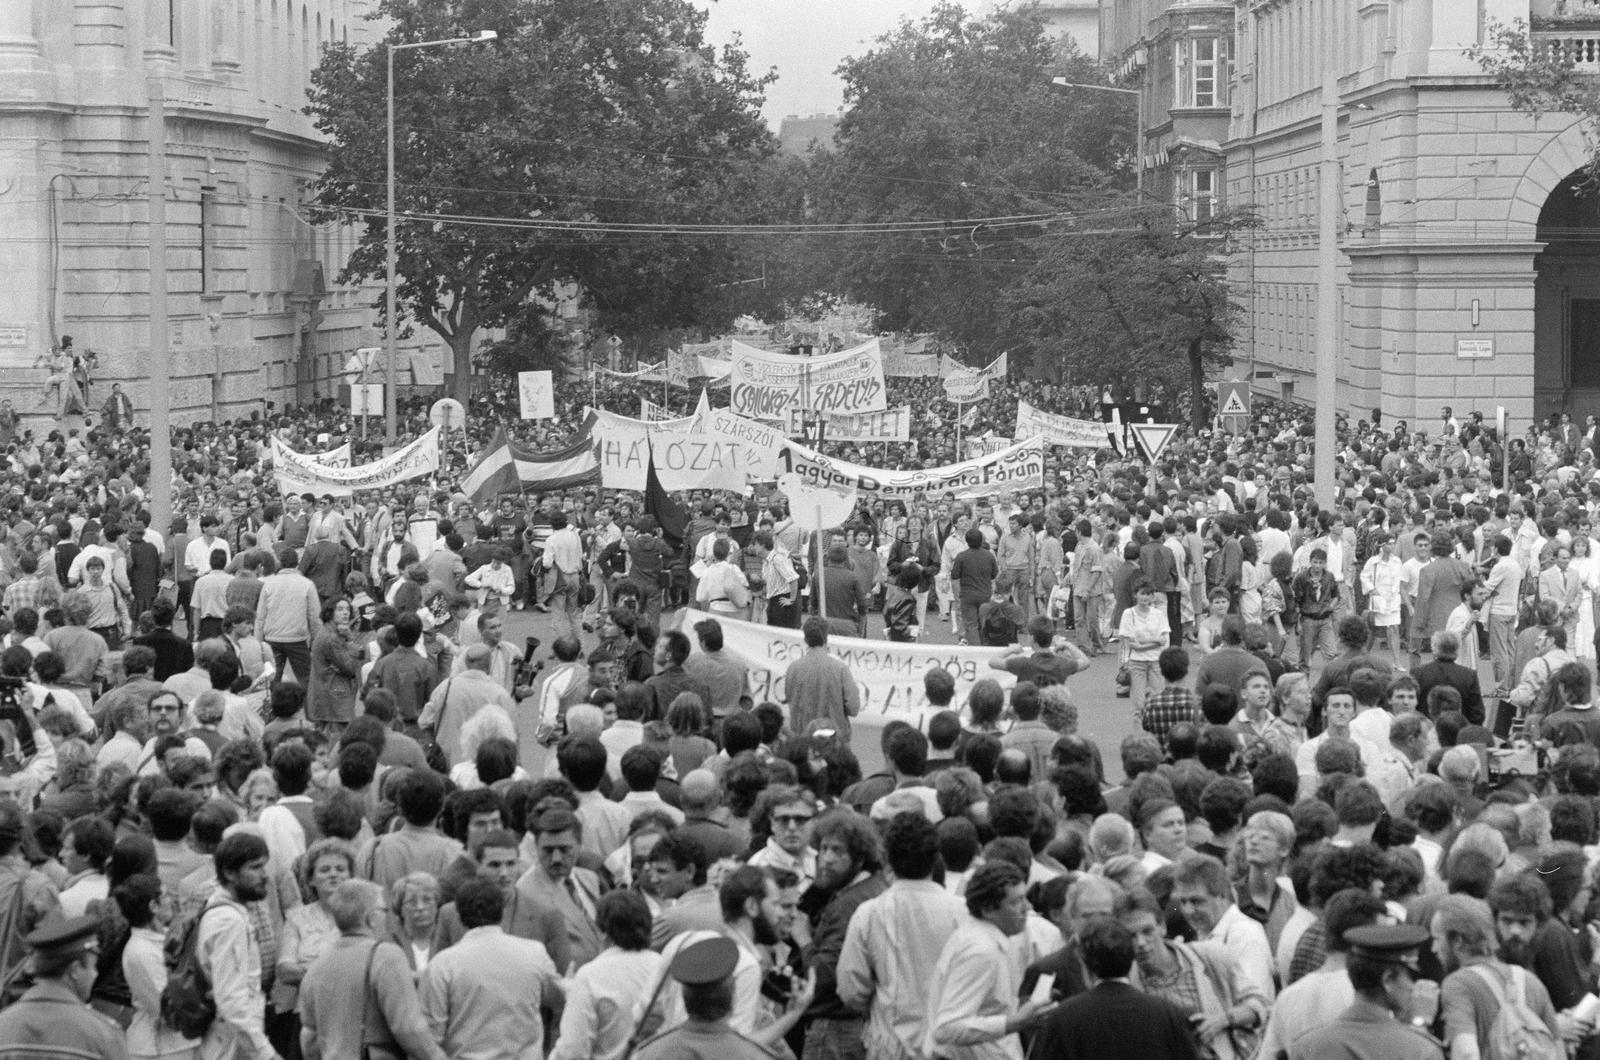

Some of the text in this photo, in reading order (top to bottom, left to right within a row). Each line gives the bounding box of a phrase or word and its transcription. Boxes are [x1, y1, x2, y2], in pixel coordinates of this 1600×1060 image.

[714, 416, 775, 449] SZÁRSZÓI
[604, 437, 740, 471] HÁLÓZAT
[857, 472, 981, 495] Demokrata
[982, 459, 1041, 485] Fórum
